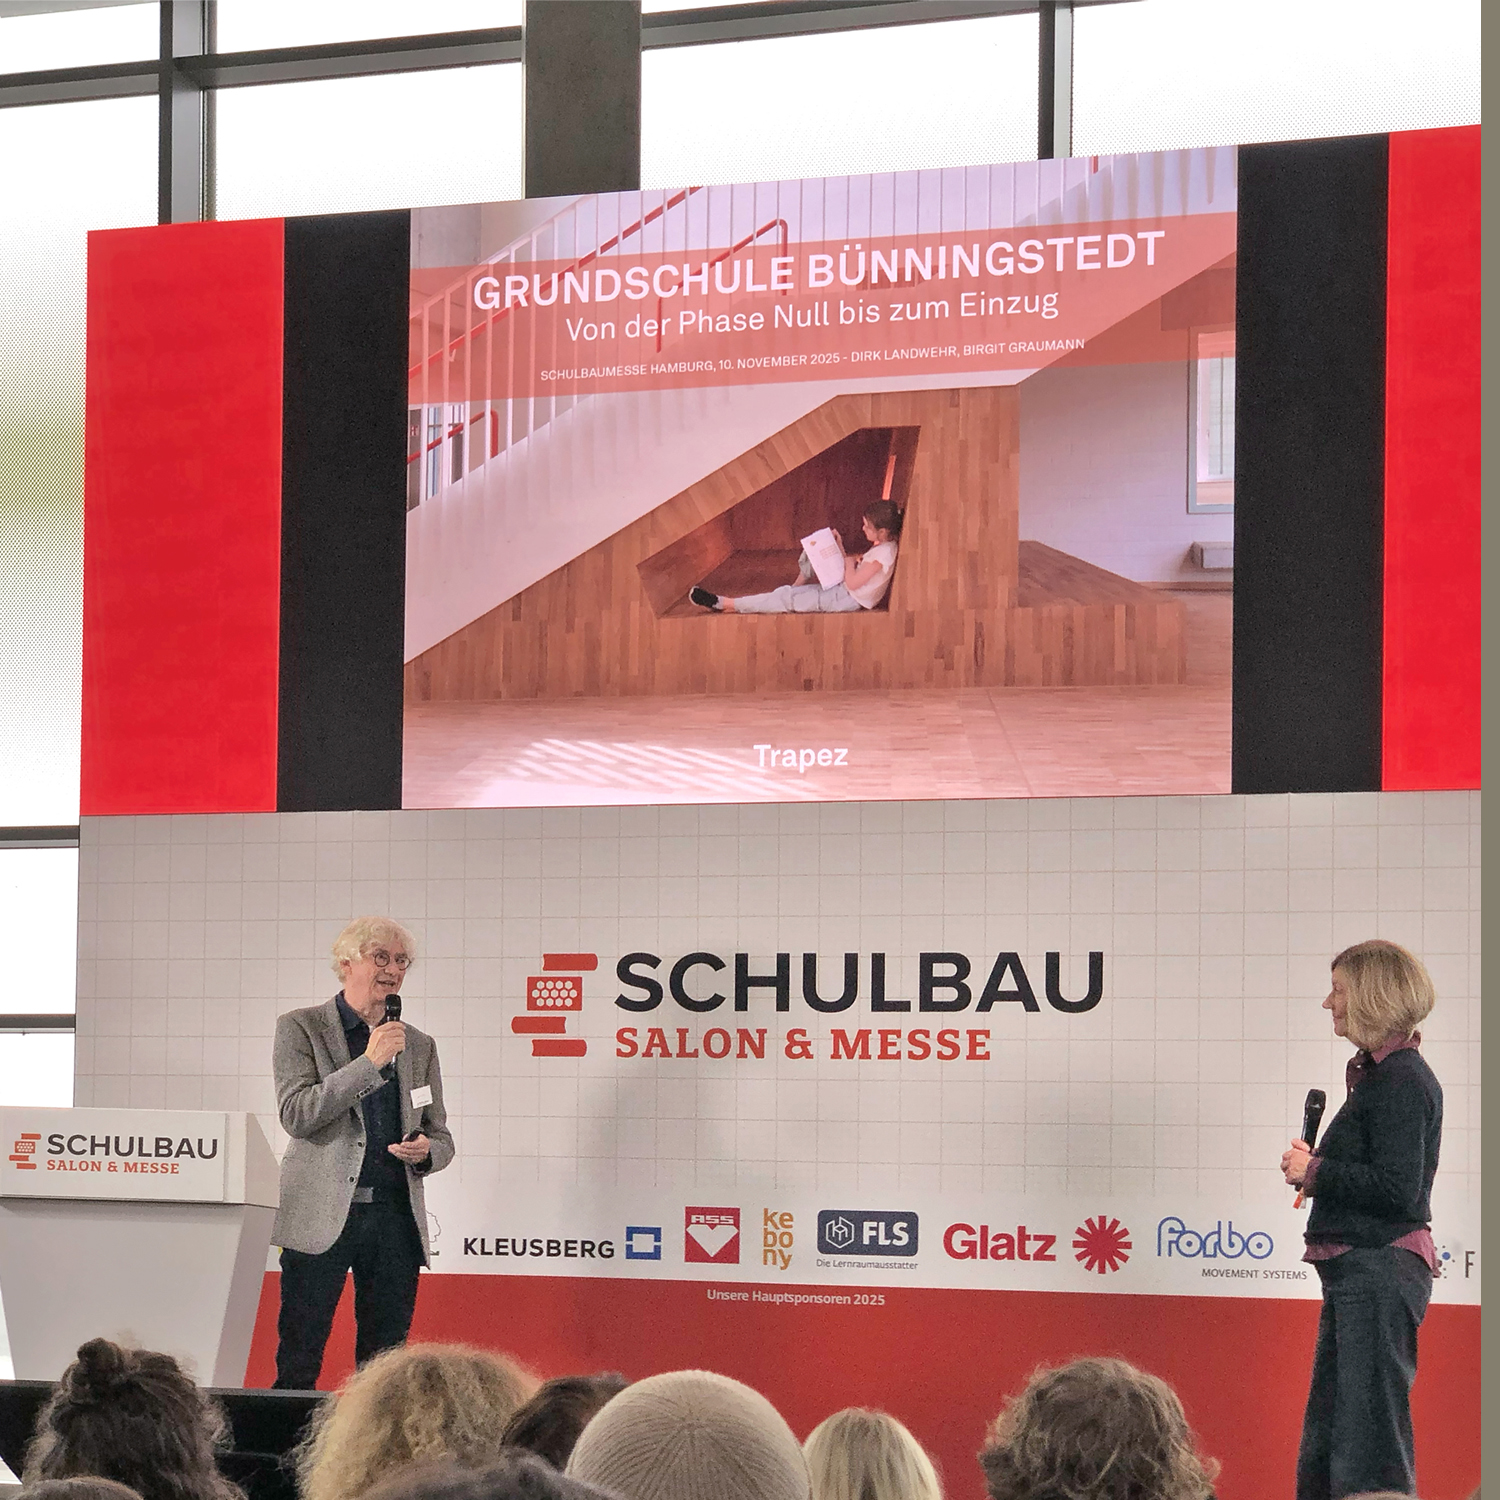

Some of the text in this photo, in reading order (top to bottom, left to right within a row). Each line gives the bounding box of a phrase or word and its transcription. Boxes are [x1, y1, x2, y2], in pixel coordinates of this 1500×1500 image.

[473, 230, 1166, 311] GRUNDSCHULE BÜNNINGSTEDT
[566, 291, 1059, 342] Von der Phase Null bis zum Einzug
[540, 364, 647, 381] SCHULBAUMESSE
[650, 359, 717, 375] HAMBURG,
[718, 359, 734, 371] 10.
[737, 355, 808, 370] NOVEMBER
[810, 353, 840, 366] 2025
[851, 350, 882, 363] DIRK
[884, 345, 961, 362] LANDWEHR,
[963, 342, 1006, 357] BIRGIT
[1008, 338, 1085, 354] GRAUMANN
[753, 744, 848, 773] Trapez
[614, 951, 1104, 1014] SCHULBAU
[615, 1027, 992, 1062] SALON & MESSE
[47, 1133, 218, 1160] SCHULBAU
[47, 1159, 180, 1175] SALON & MESSE
[862, 1221, 910, 1247] FLS
[943, 1222, 1057, 1262] Glatz
[463, 1237, 615, 1260] KLEUSBERG
[816, 1259, 919, 1271] Die Lernraumausstatter
[1202, 1268, 1308, 1281] MOVEMENT SYSTEMS
[707, 1288, 886, 1307] Unsere Hauptsponsoren 2025
